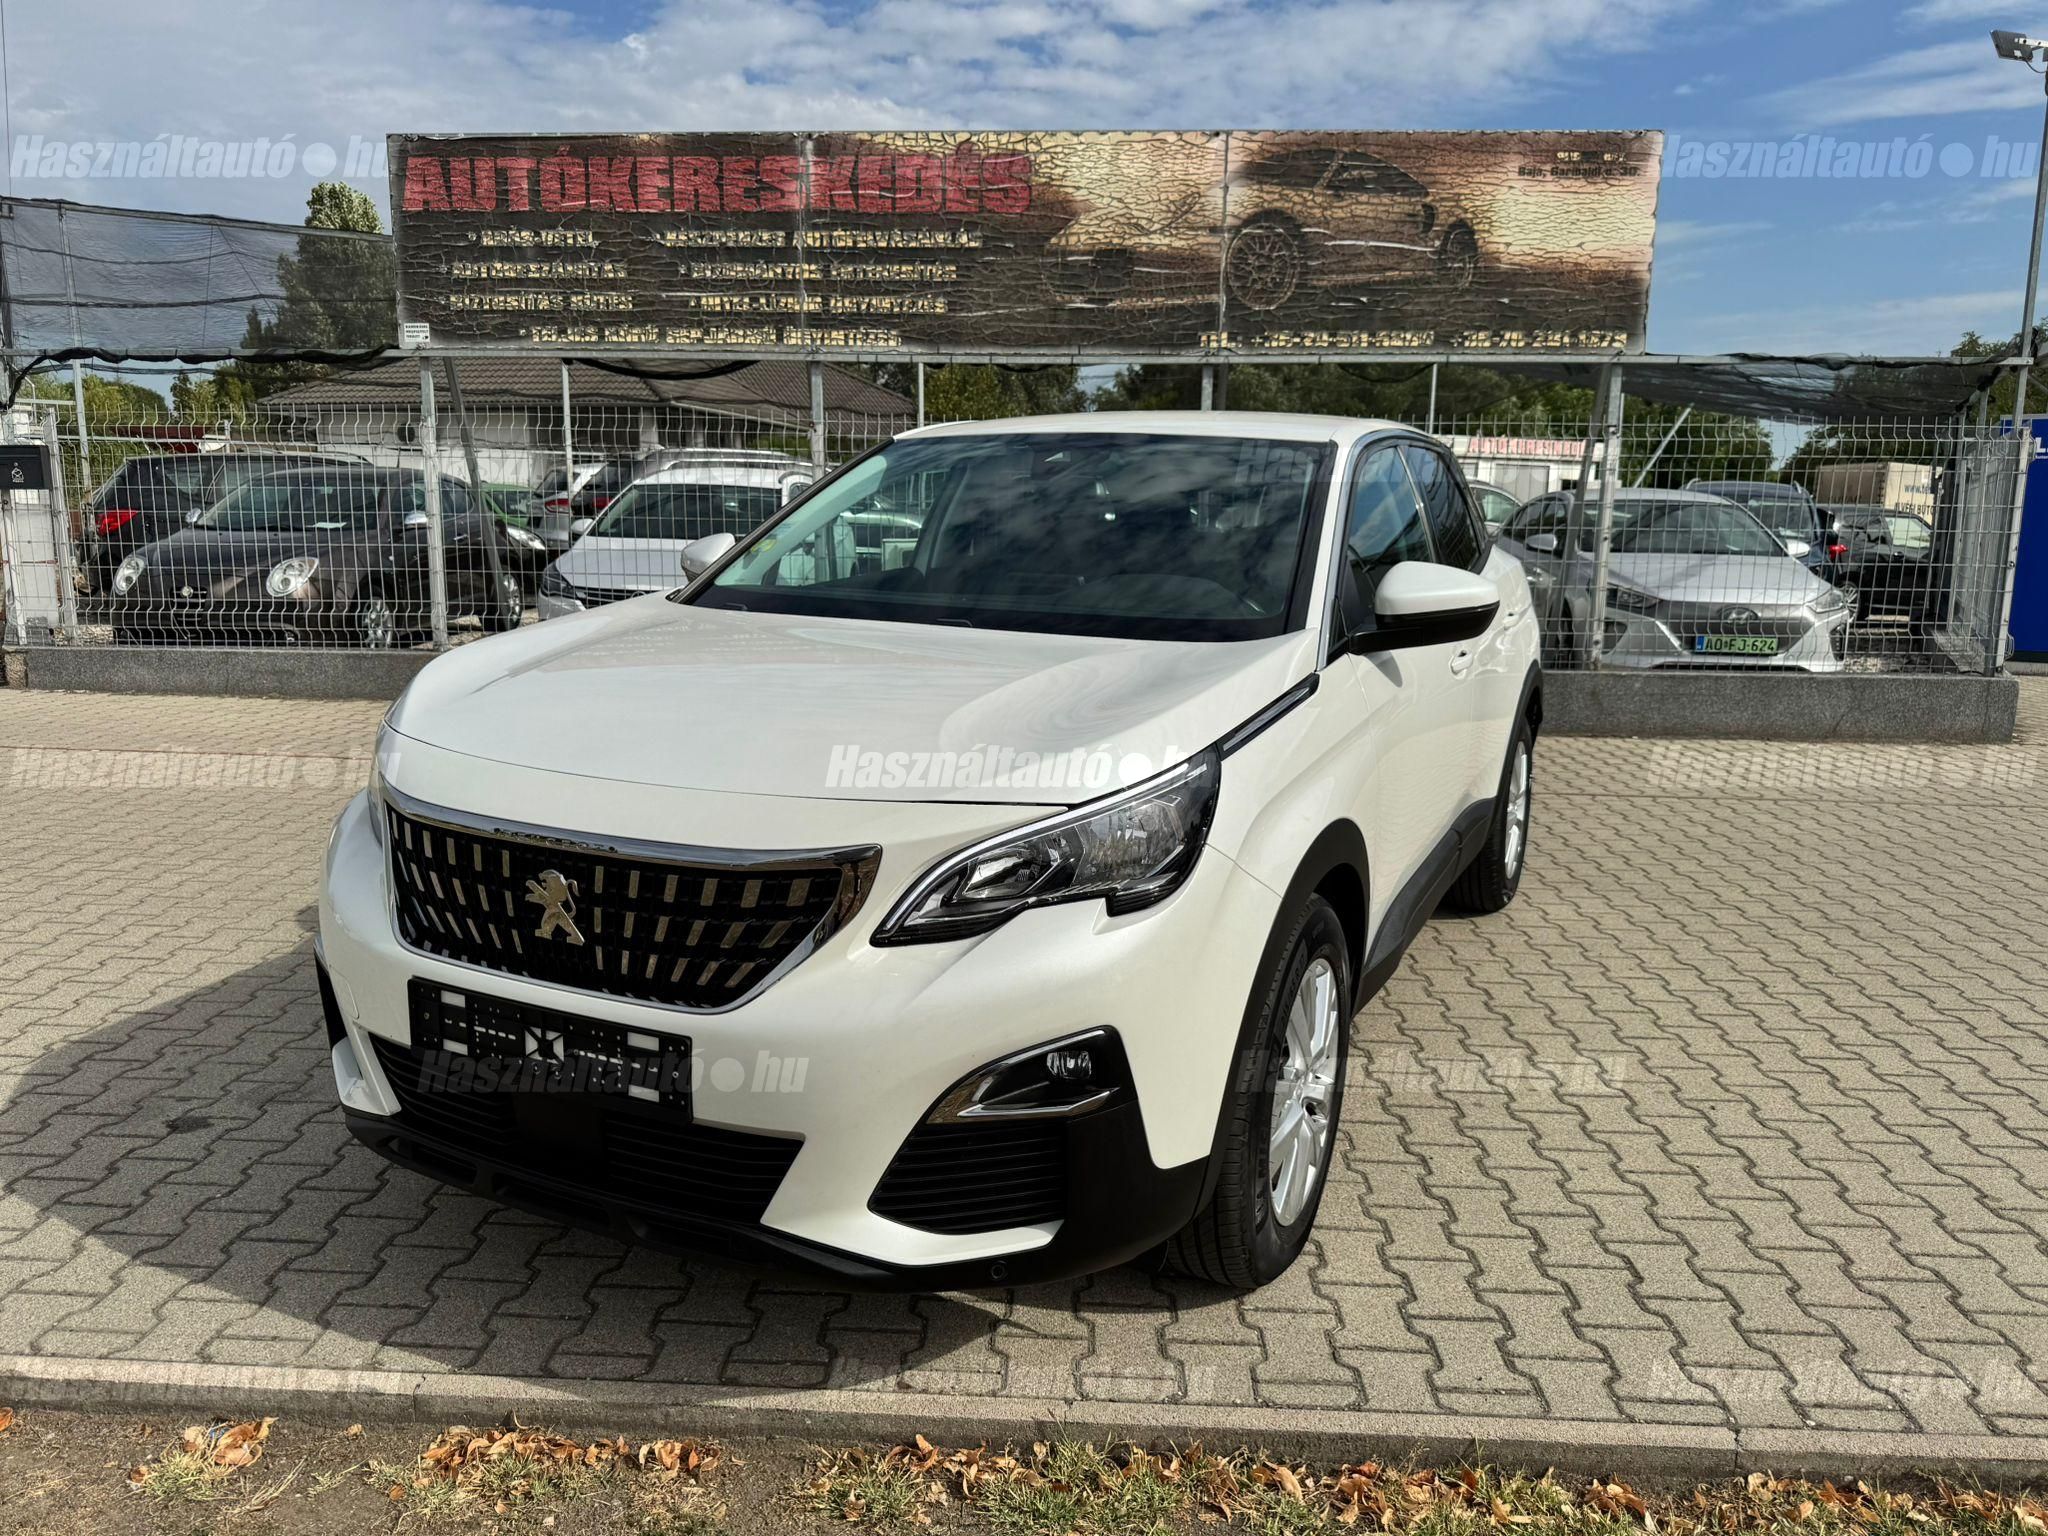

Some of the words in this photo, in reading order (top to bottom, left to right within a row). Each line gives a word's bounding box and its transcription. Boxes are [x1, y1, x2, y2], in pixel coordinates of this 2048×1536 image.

[402, 144, 1031, 213] AUTÓKERESKEDÉS
[1518, 166, 1546, 178] Baja,
[1550, 166, 1601, 177] Garibaldi
